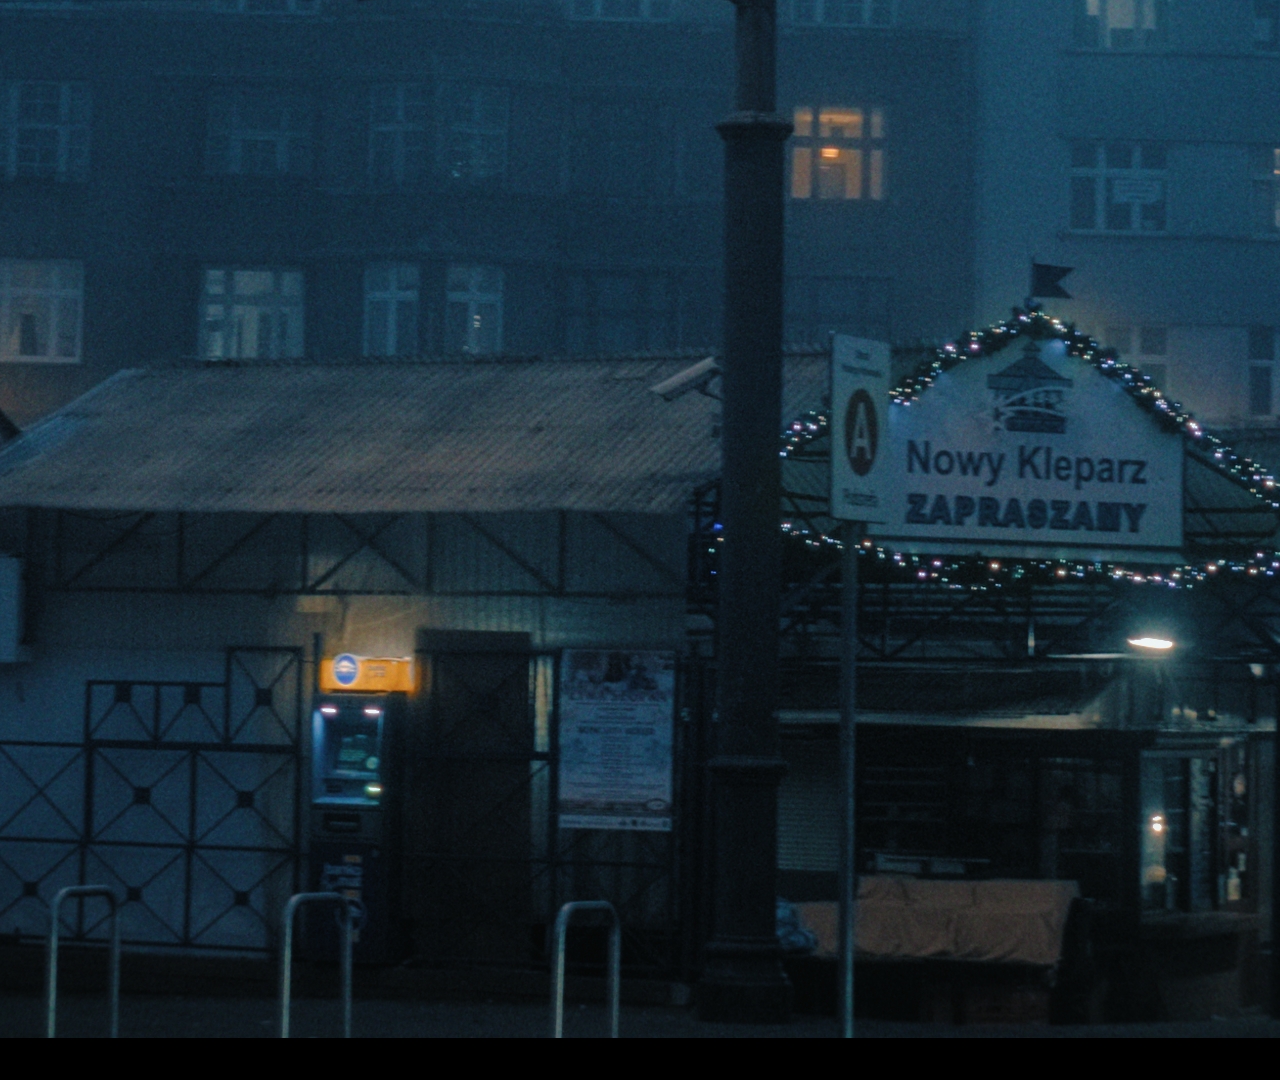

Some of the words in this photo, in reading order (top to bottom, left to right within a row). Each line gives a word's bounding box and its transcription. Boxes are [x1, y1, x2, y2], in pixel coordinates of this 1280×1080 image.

[850, 401, 872, 460] A
[906, 439, 1005, 487] Nowy
[1017, 444, 1148, 490] Kleparz
[905, 492, 1147, 533] ZAPRASZAMY
